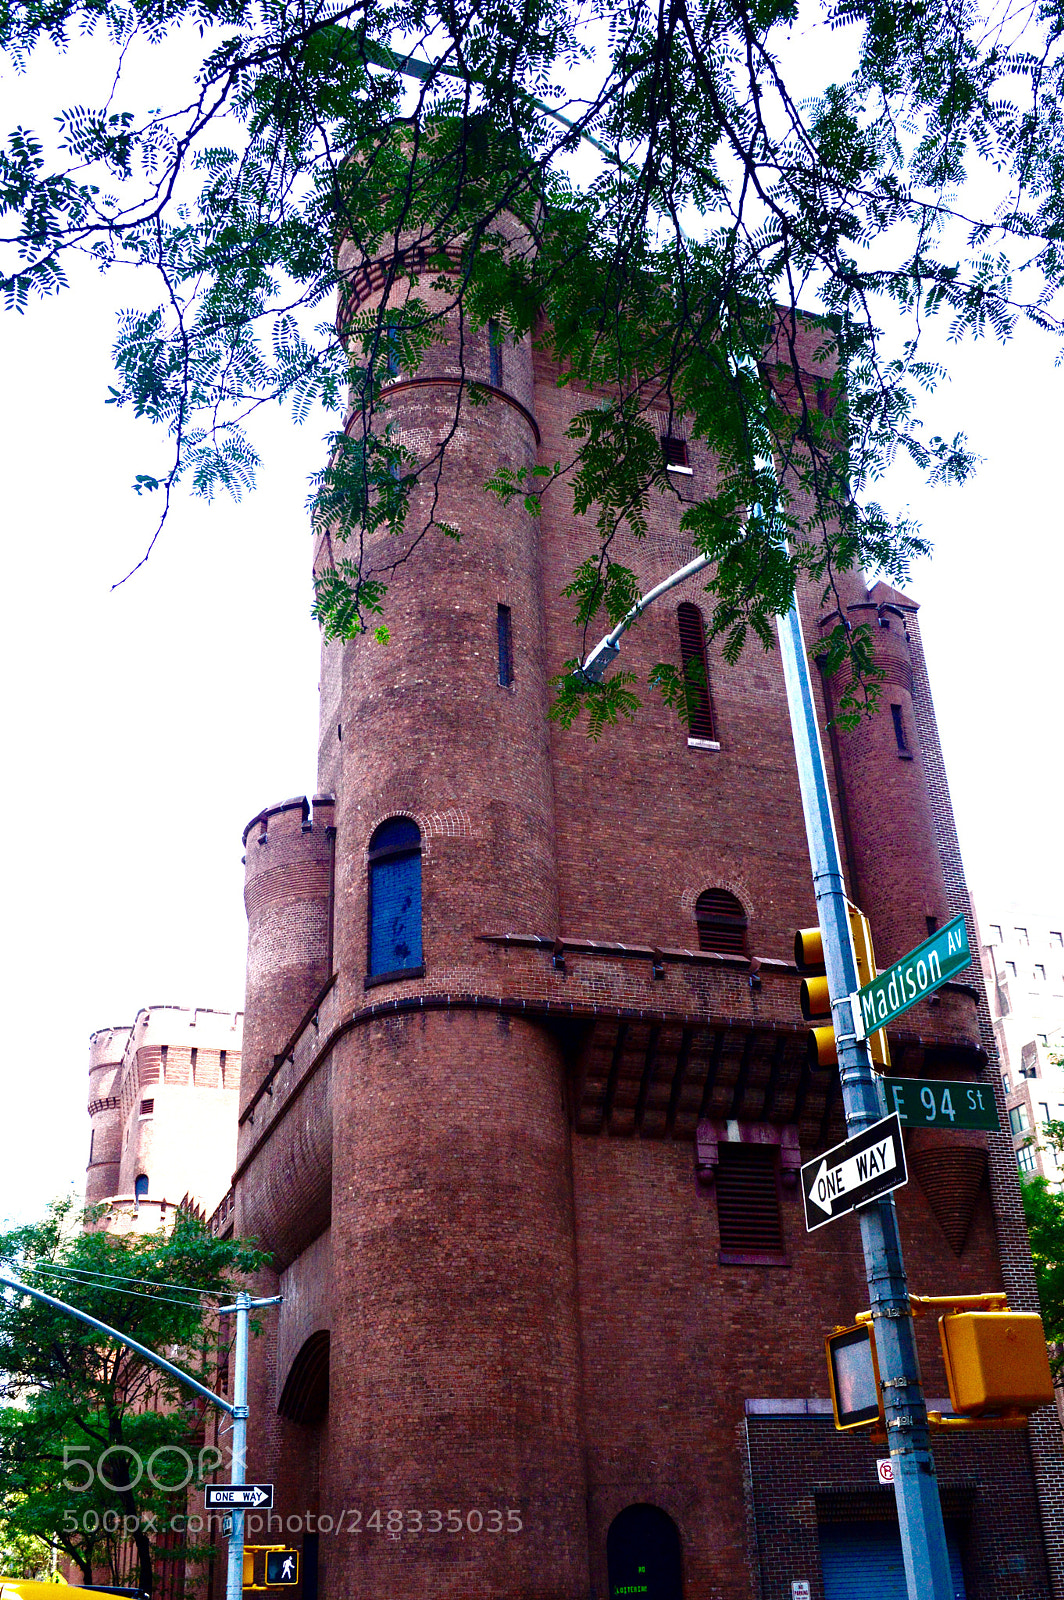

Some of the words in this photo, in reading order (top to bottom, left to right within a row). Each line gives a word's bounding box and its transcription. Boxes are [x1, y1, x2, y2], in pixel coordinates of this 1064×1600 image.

[862, 949, 944, 1029] Madison
[947, 929, 963, 956] Av
[892, 1086, 908, 1119] E
[920, 1087, 956, 1122] 94
[967, 1090, 985, 1111] St
[818, 1168, 845, 1202] ONE
[857, 1143, 888, 1181] WAY
[215, 1492, 235, 1502] ONE
[243, 1492, 263, 1502] WAY
